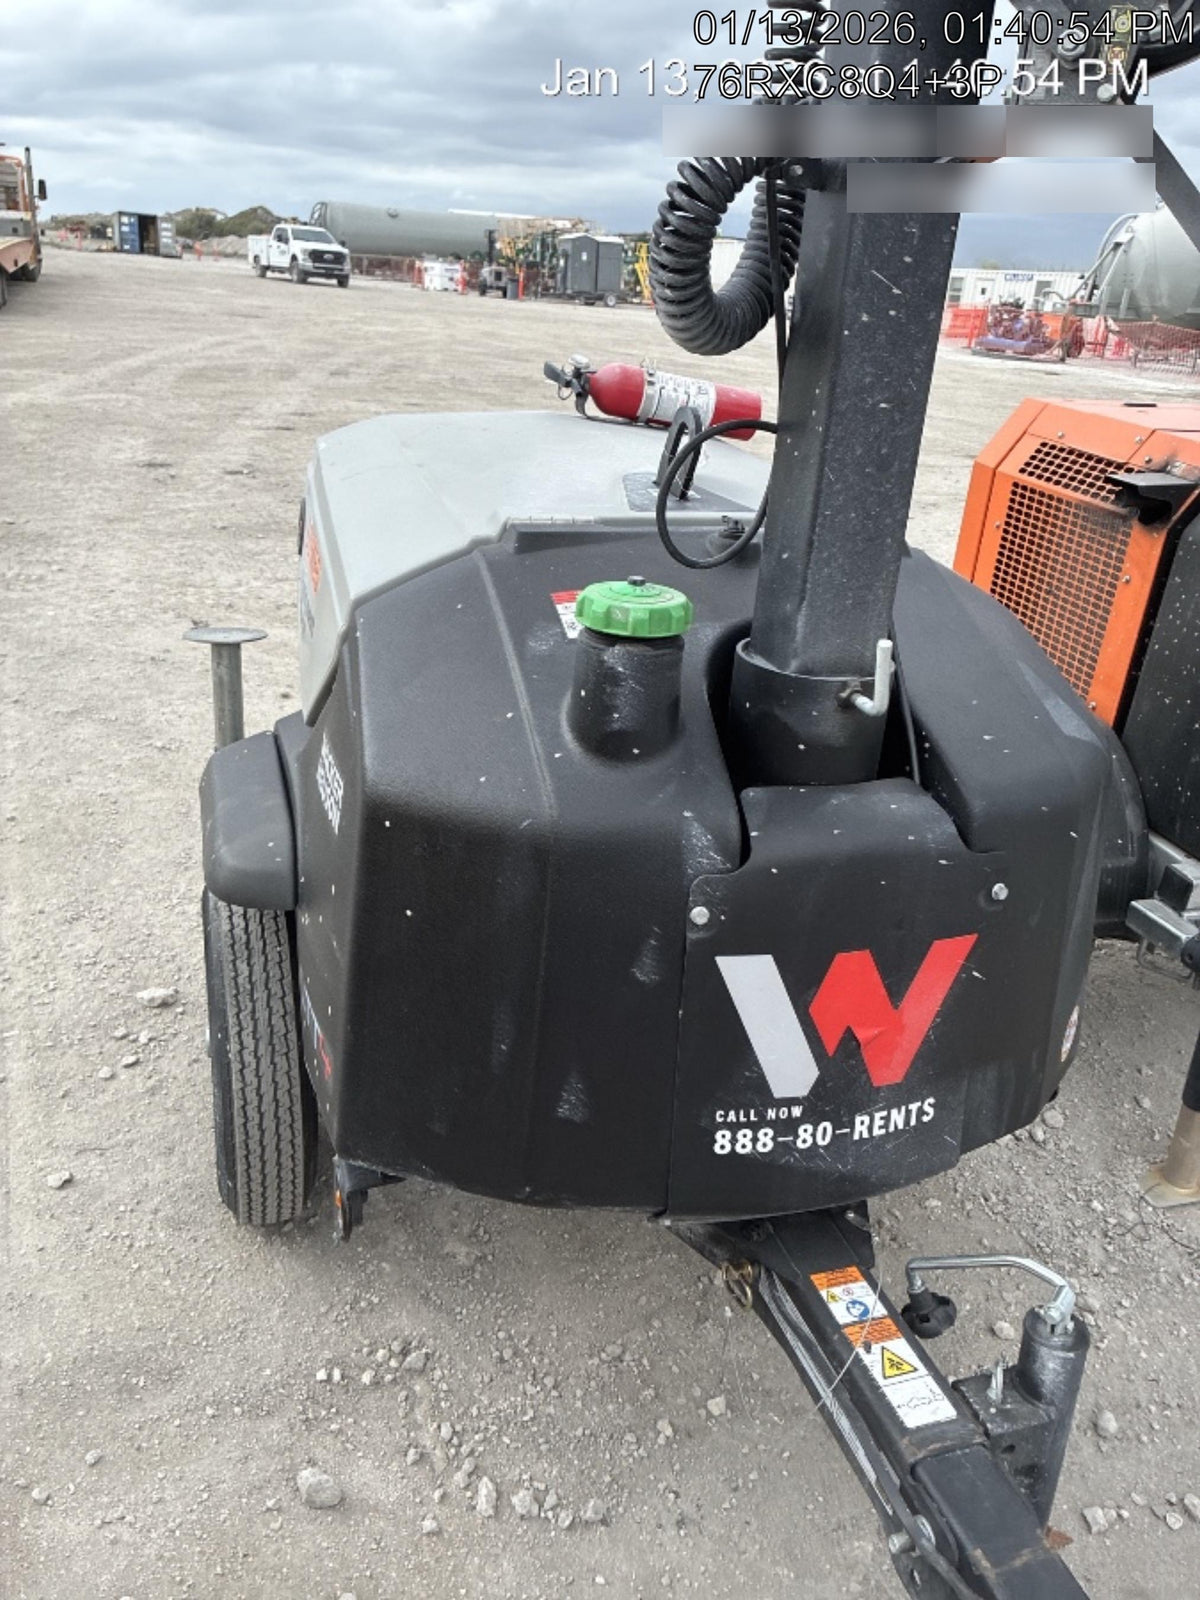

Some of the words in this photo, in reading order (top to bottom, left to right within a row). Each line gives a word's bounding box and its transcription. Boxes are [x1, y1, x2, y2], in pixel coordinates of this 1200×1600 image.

[713, 1096, 936, 1155] 888-80-RENTS
[715, 1108, 758, 1123] CALL
[766, 1105, 804, 1121] NOW
